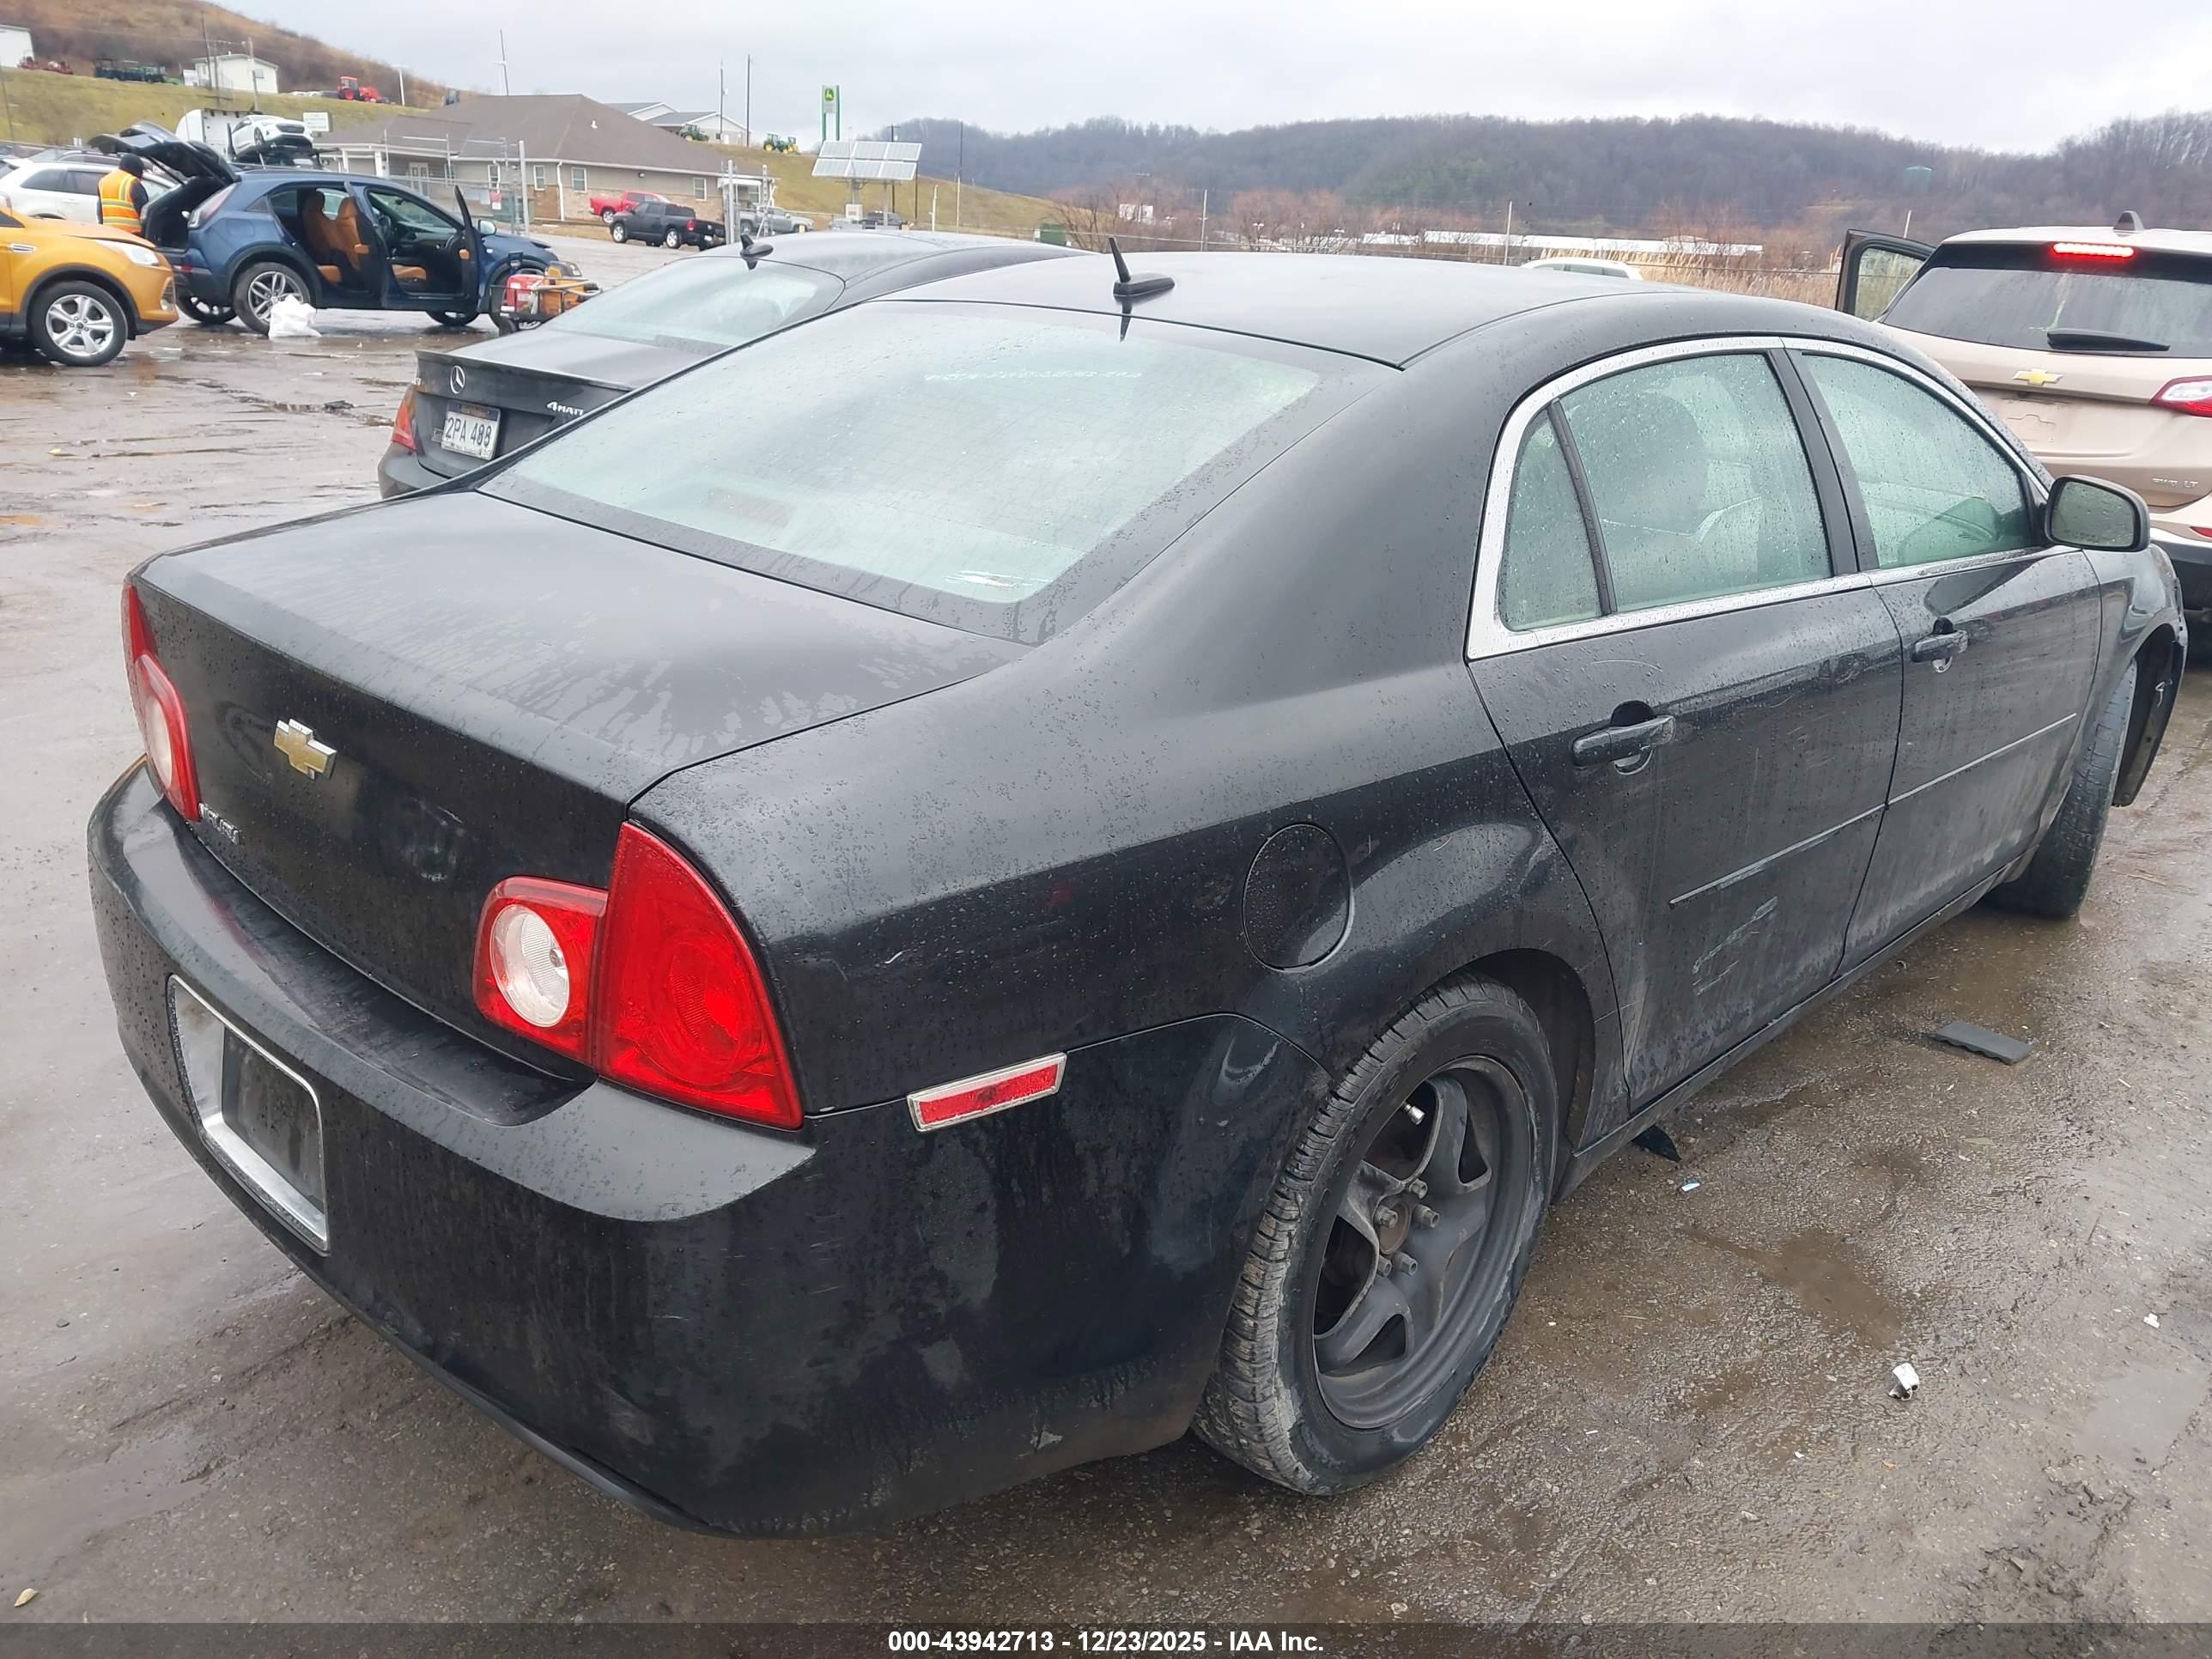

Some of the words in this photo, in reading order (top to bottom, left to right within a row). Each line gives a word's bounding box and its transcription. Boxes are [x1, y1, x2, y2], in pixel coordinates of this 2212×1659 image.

[547, 401, 584, 416] 4MATI
[445, 417, 466, 441] 2PA
[471, 422, 492, 447] 488
